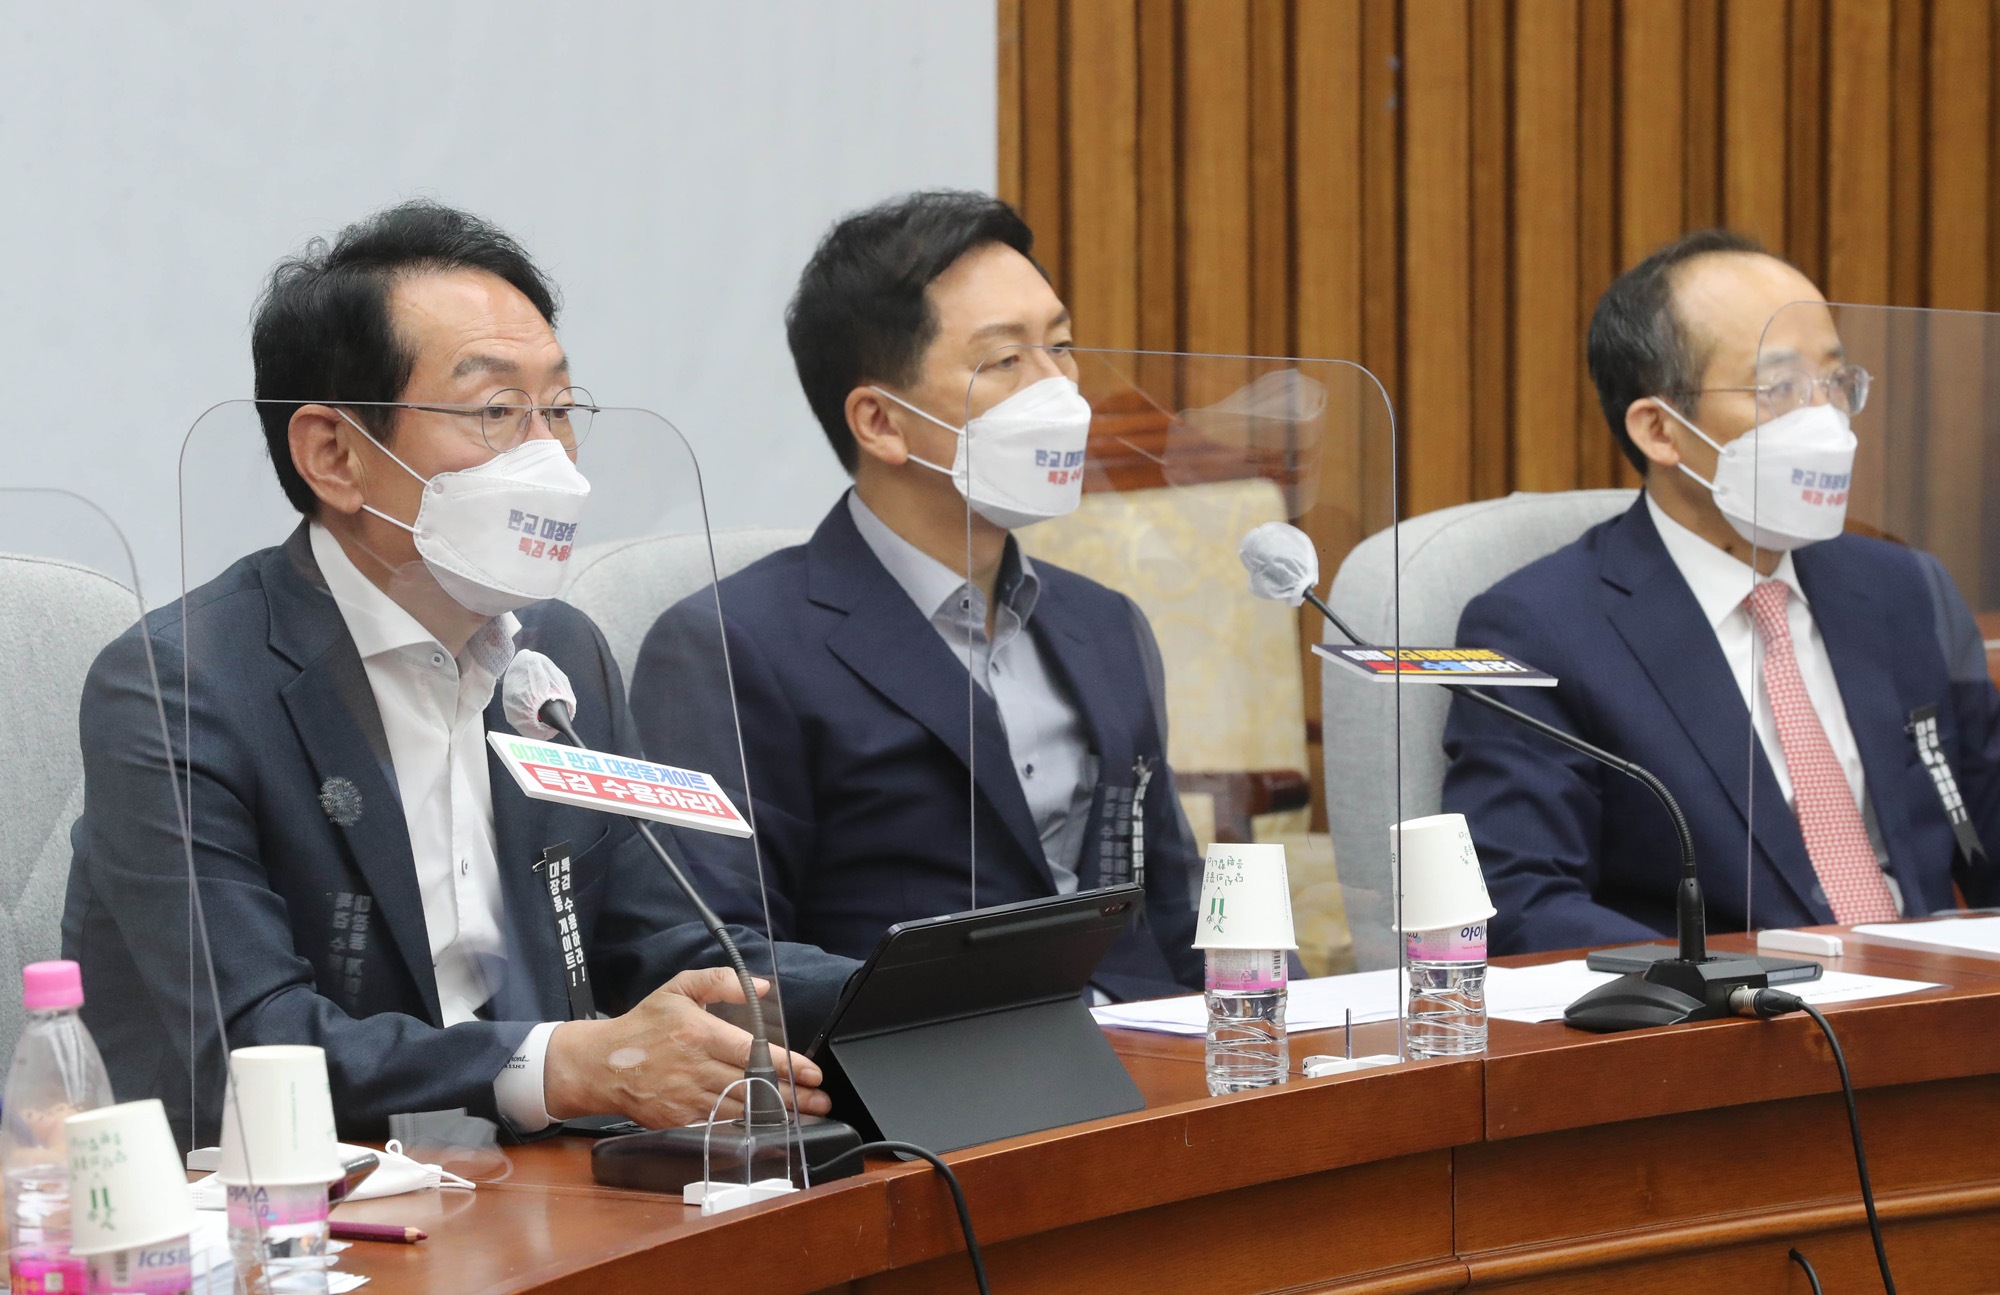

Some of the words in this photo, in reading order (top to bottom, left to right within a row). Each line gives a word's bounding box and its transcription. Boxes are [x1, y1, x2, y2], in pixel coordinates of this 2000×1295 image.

[508, 509, 539, 535] 판교
[518, 537, 546, 559] 특검
[509, 742, 565, 767] 이재명
[567, 751, 602, 773] 판교
[603, 757, 710, 791] 대장동게이트
[533, 767, 598, 795] 특검
[600, 780, 725, 816] 수용하라!
[561, 856, 571, 891] 특검
[549, 860, 564, 913] 대장동
[557, 917, 577, 987] 게이트!
